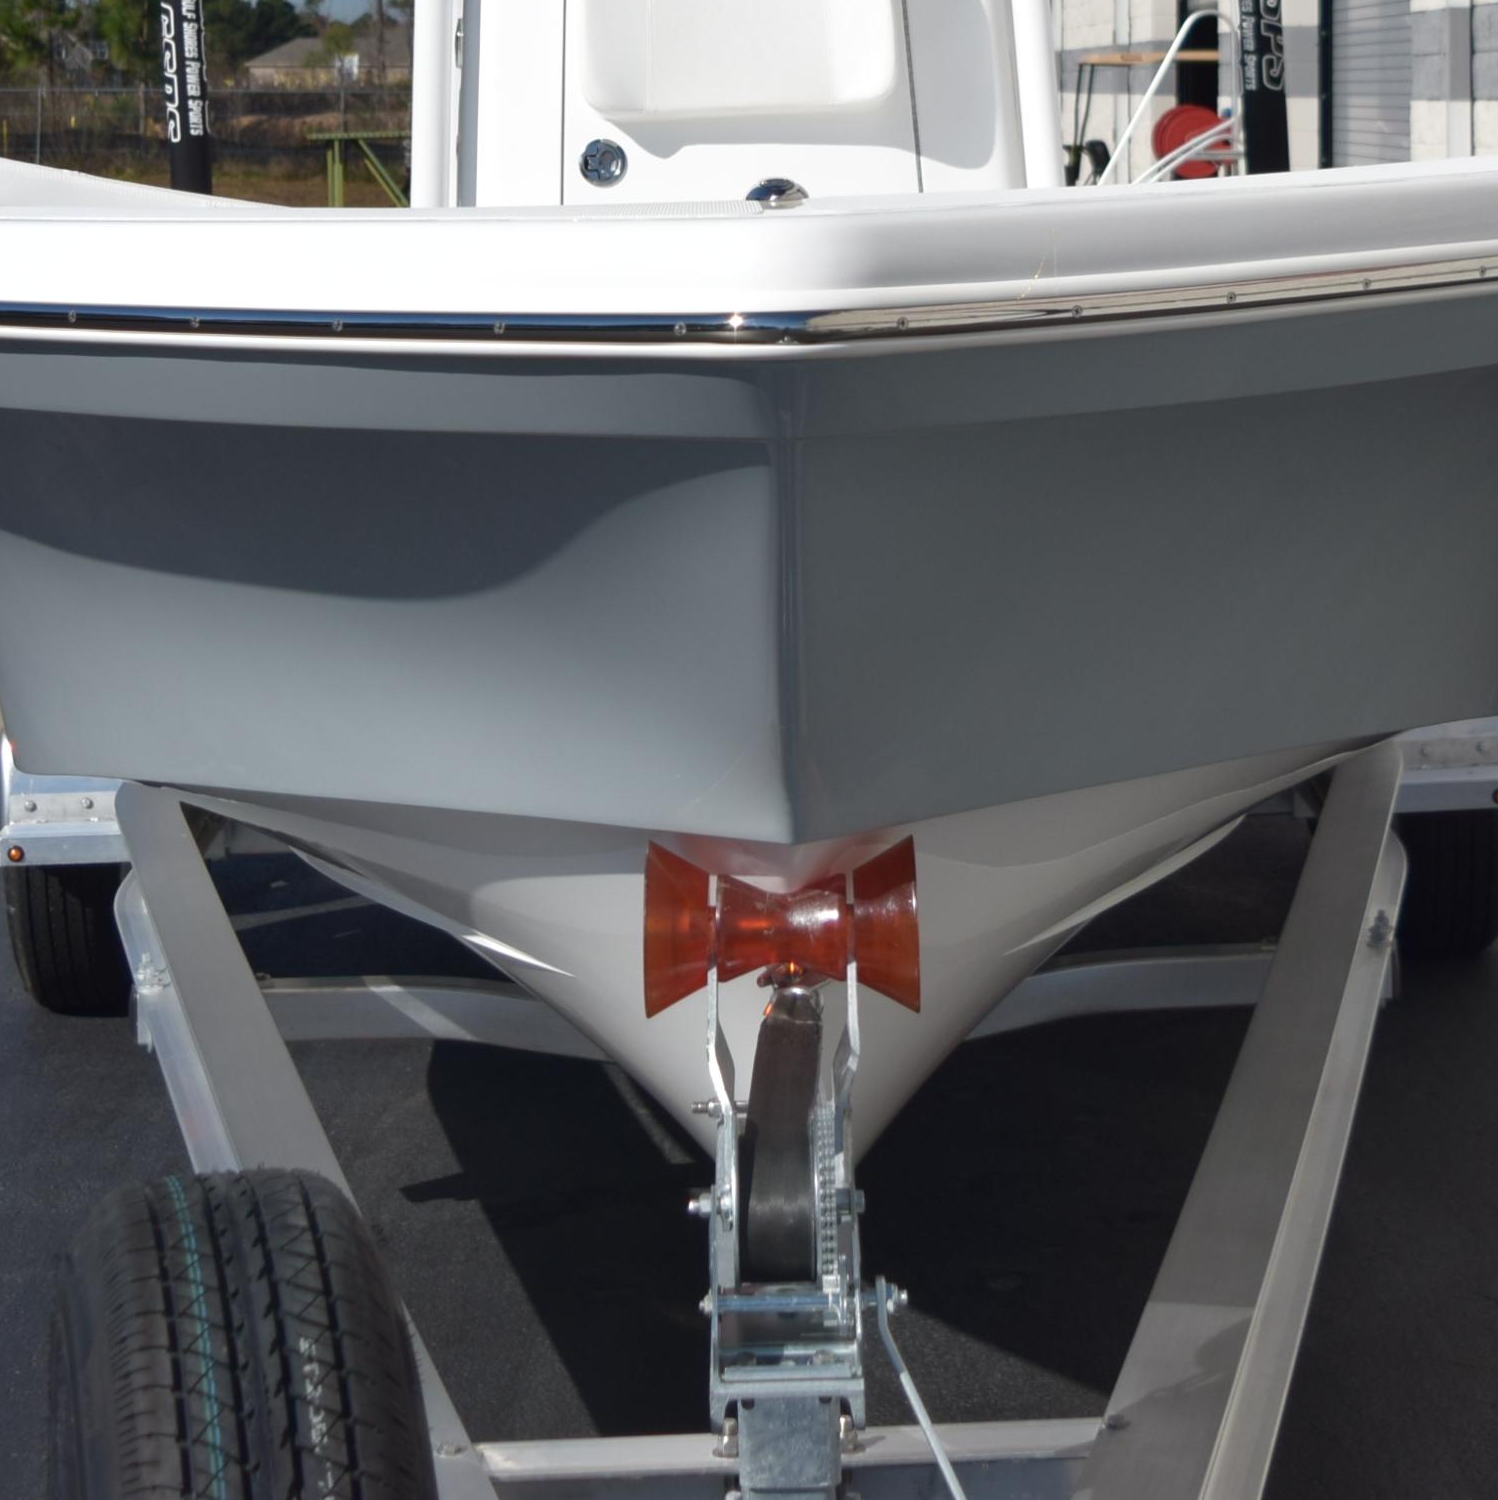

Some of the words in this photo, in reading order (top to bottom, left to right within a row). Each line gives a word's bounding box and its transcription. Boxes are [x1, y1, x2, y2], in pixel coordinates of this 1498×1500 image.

[183, 21, 199, 59] SHORES
[1242, 15, 1256, 52] POWER
[185, 61, 201, 97] POWER
[1244, 54, 1258, 91] SPORTS
[188, 98, 204, 137] SPORTS
